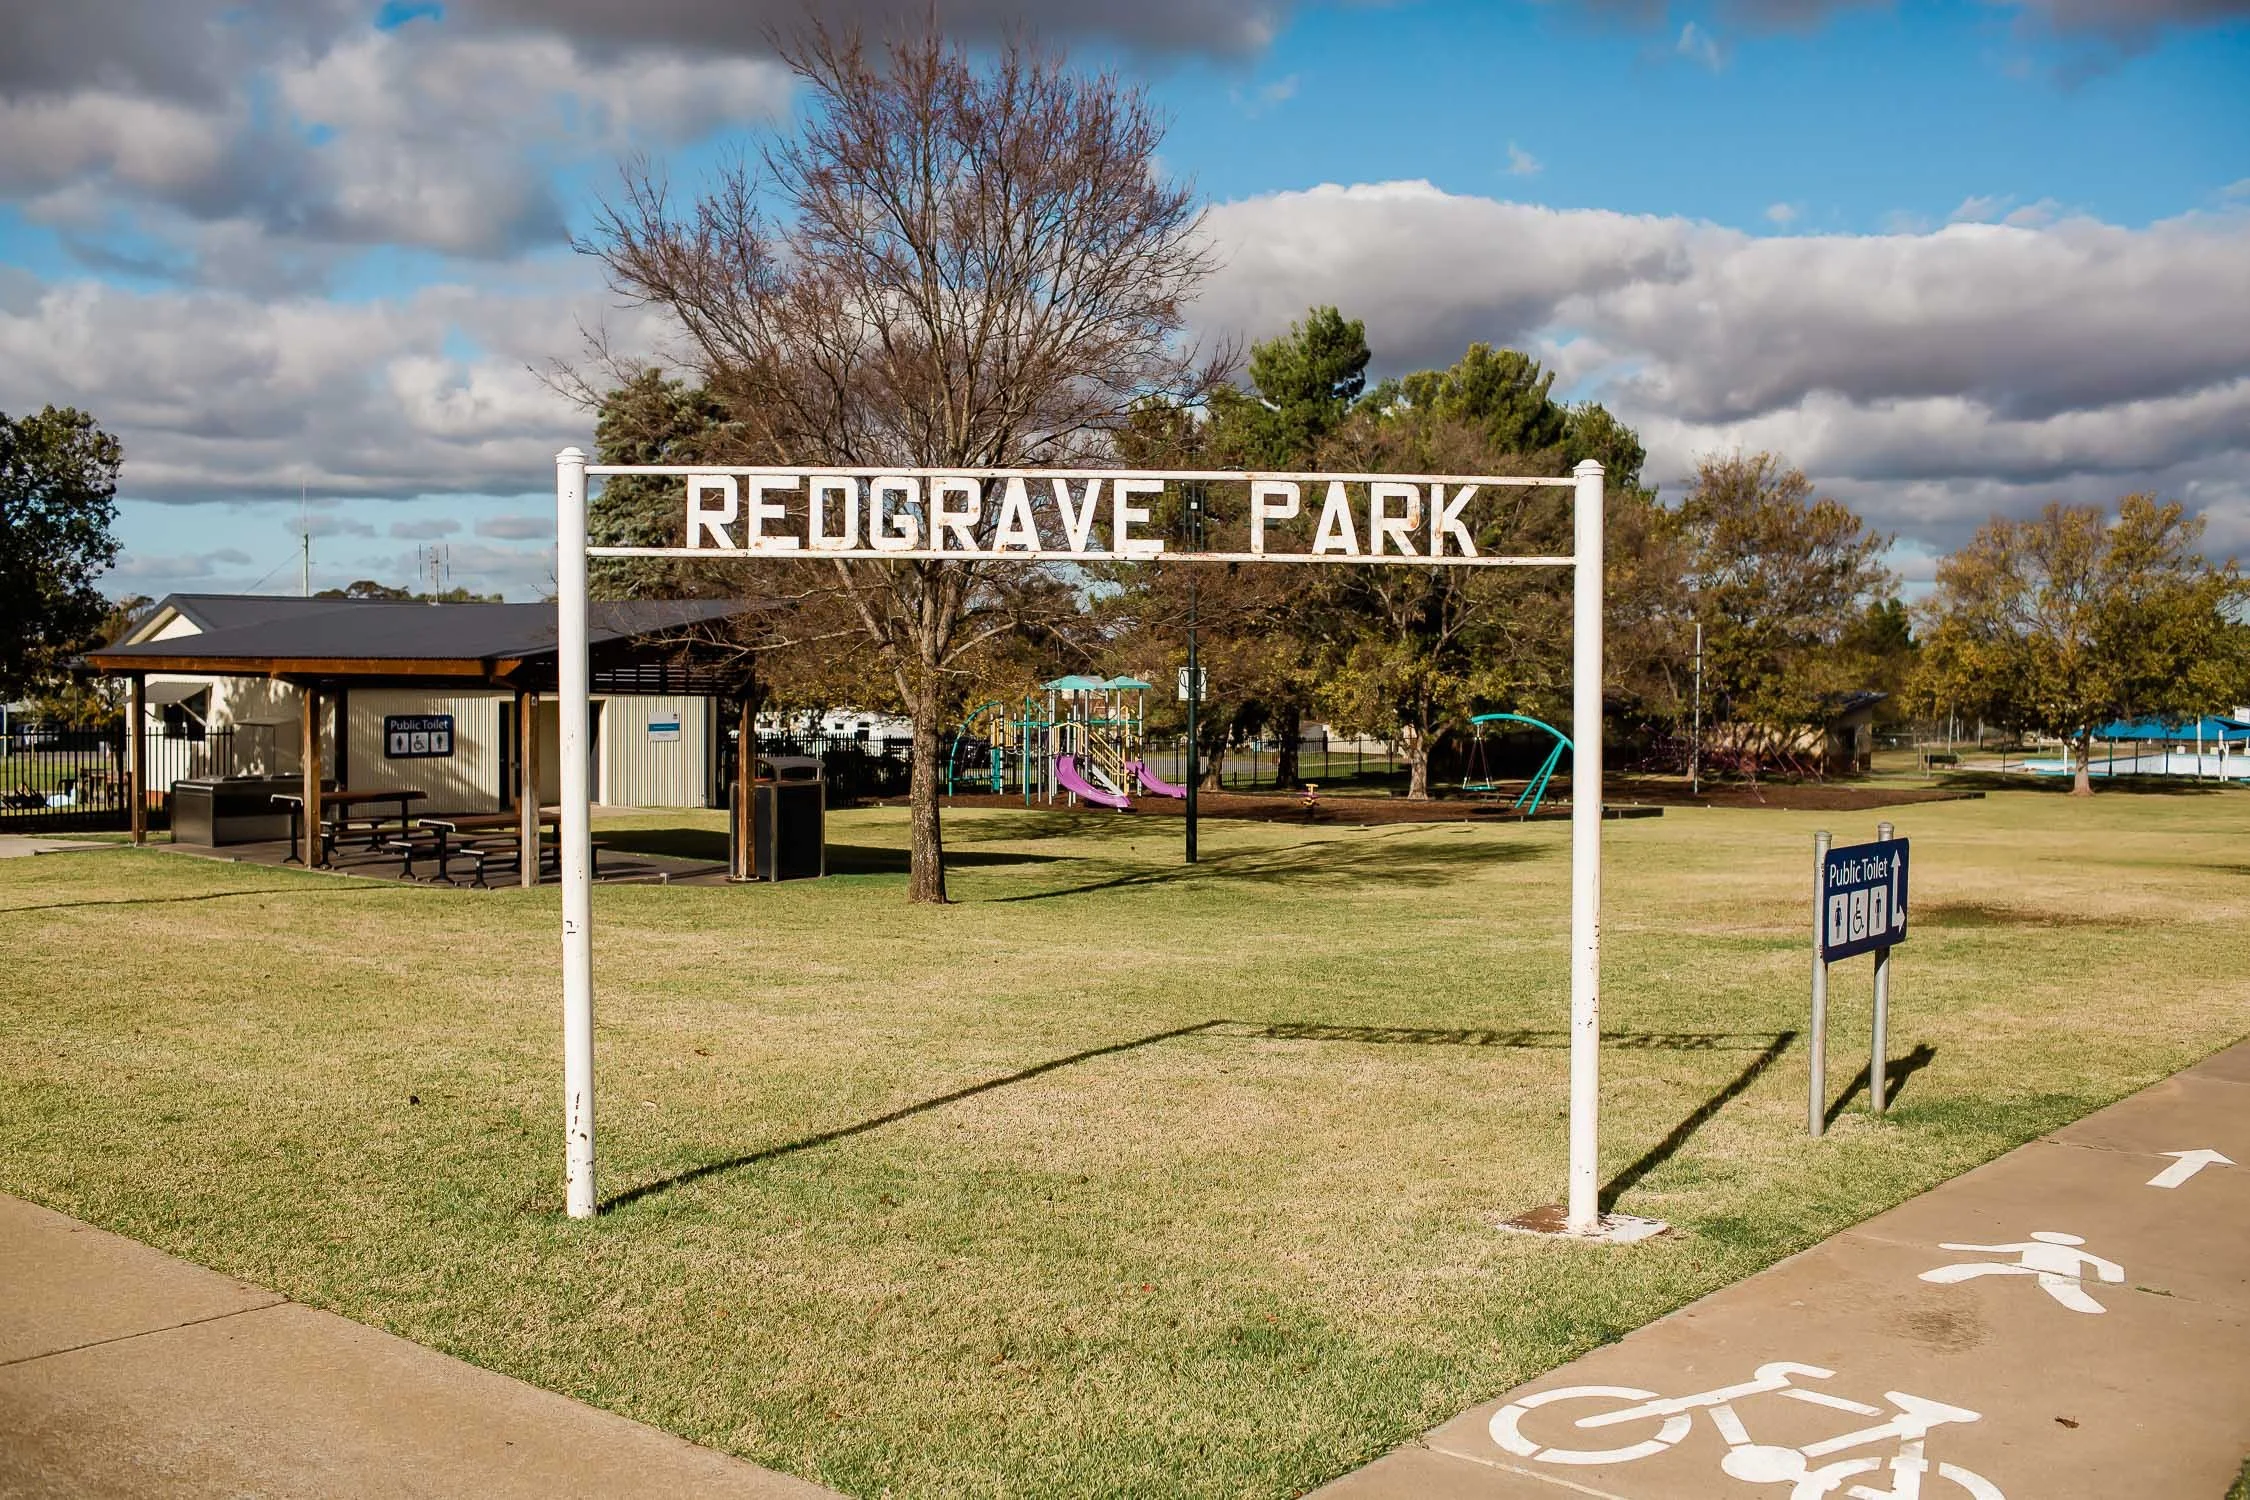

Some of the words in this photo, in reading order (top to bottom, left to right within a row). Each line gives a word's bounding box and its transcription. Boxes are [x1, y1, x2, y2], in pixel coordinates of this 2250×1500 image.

[686, 474, 1165, 553] REDGRAVE
[1251, 480, 1481, 558] PARK
[390, 719, 420, 730] Public
[423, 719, 448, 730] Toilet
[1829, 859, 1861, 888] Public
[1862, 855, 1888, 881] Toilet
